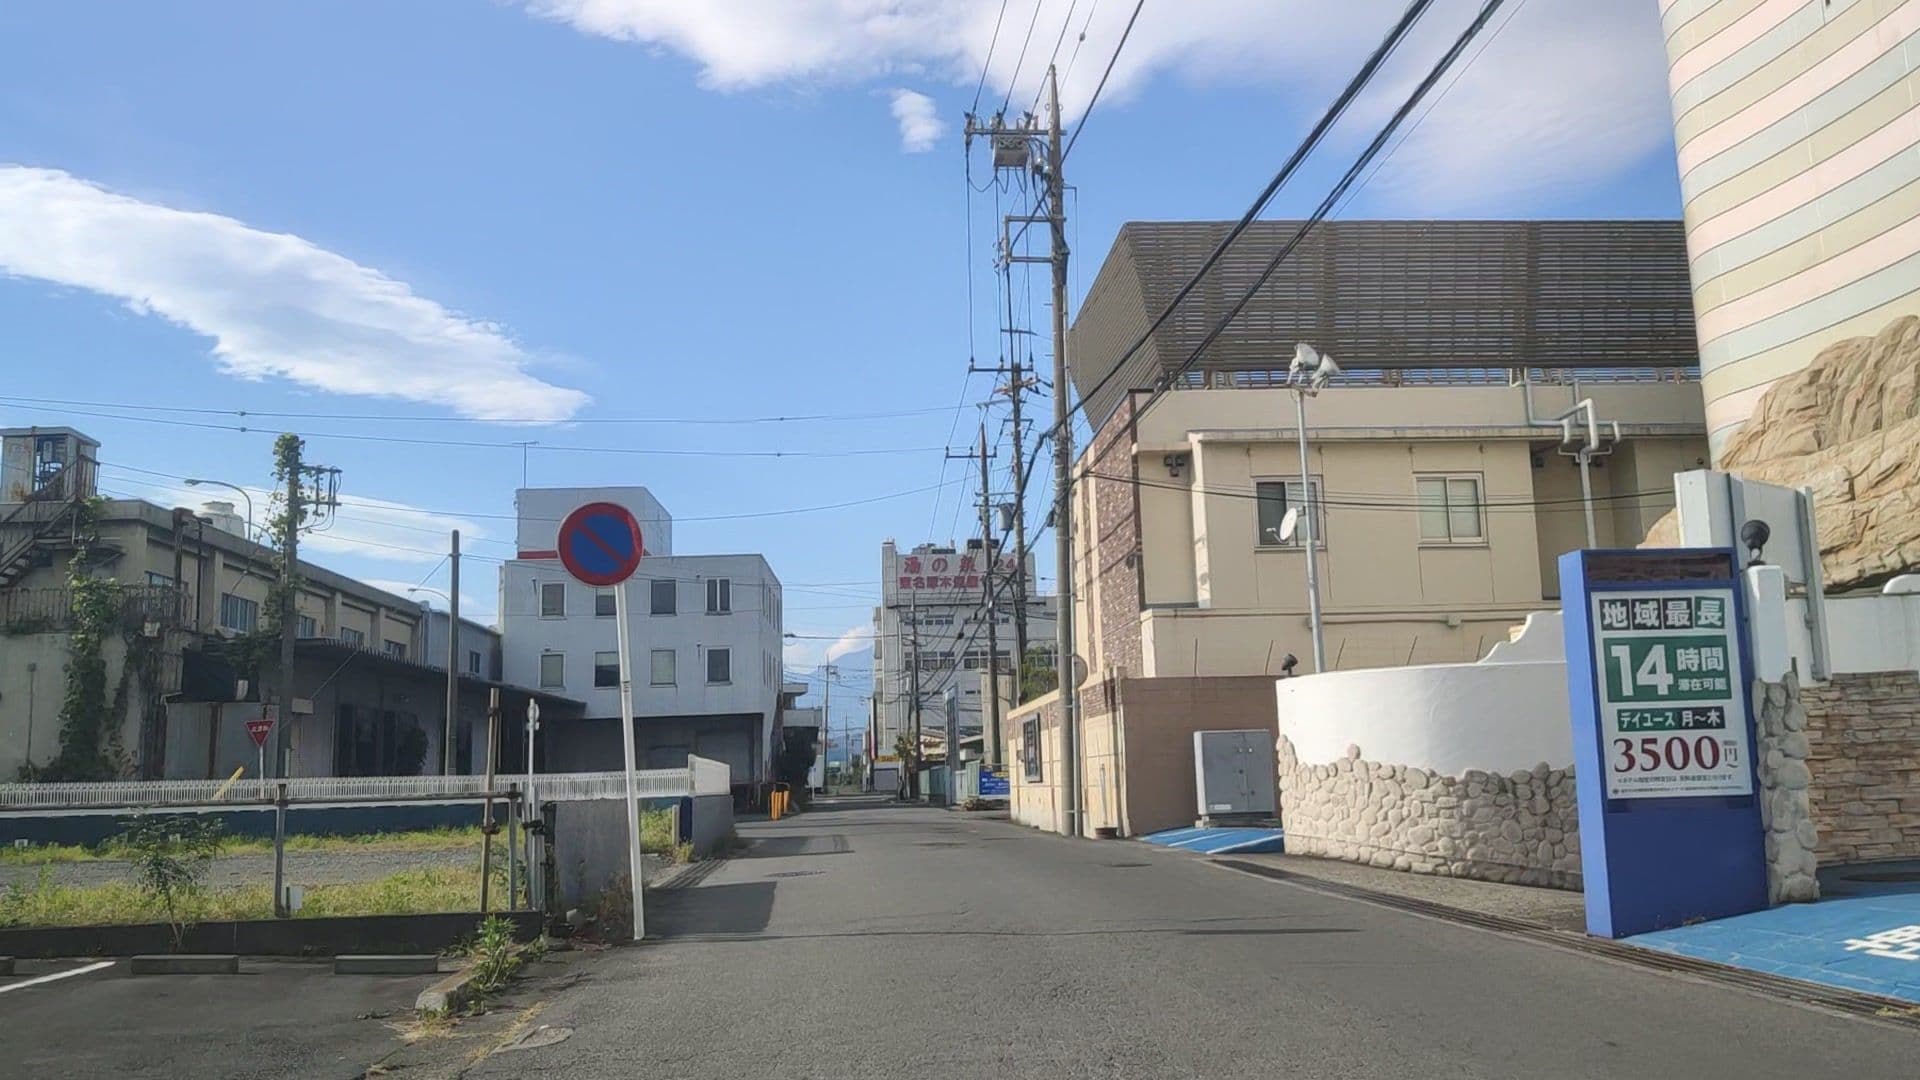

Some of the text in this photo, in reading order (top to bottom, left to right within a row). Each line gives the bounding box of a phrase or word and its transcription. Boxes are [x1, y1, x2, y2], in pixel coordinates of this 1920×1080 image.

[1602, 600, 1723, 628] 地域最長
[1613, 735, 1720, 773] 3500
